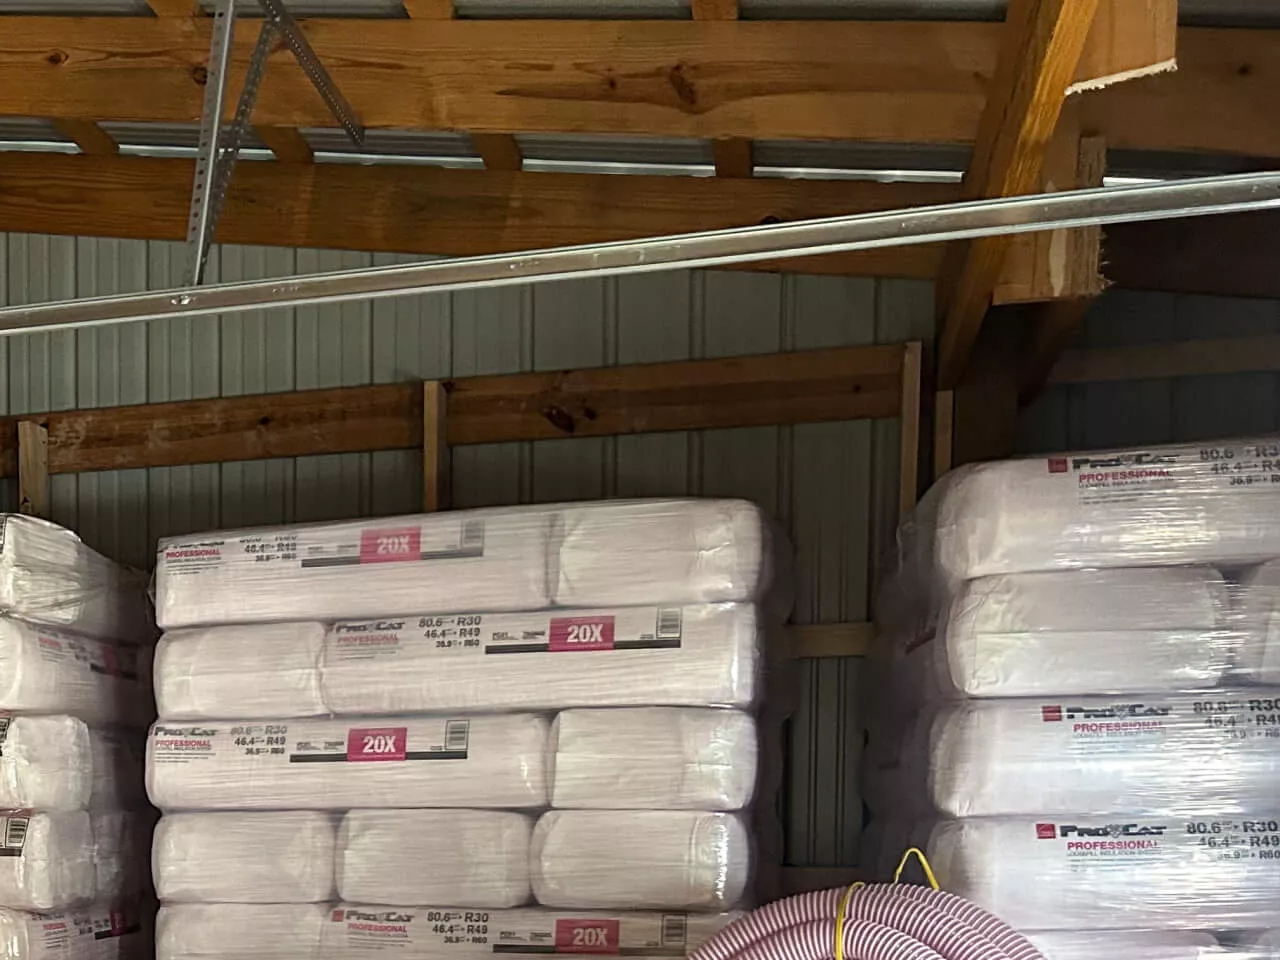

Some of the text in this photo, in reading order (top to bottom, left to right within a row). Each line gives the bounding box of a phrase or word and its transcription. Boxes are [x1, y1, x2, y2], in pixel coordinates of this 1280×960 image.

[1079, 471, 1173, 482] PROFESSIONAL
[377, 535, 409, 555] 20X
[419, 616, 481, 628] 80.6 R30
[424, 628, 480, 638] 46.4 R49
[567, 624, 603, 642] 20X
[338, 634, 398, 643] PROFESSIONAL
[265, 726, 287, 734] R30
[1073, 721, 1165, 732] PROFESSIONAL
[235, 736, 286, 745] 46.4 R49
[363, 735, 395, 753] 20X
[1186, 821, 1278, 834] 80.6 R30
[1067, 840, 1158, 850] PROFESSIONAL
[428, 912, 488, 922] 80.6 R30
[348, 923, 407, 933] PROFESSIONAL
[433, 924, 488, 934] 46.4 R49
[573, 928, 609, 946] 20X
